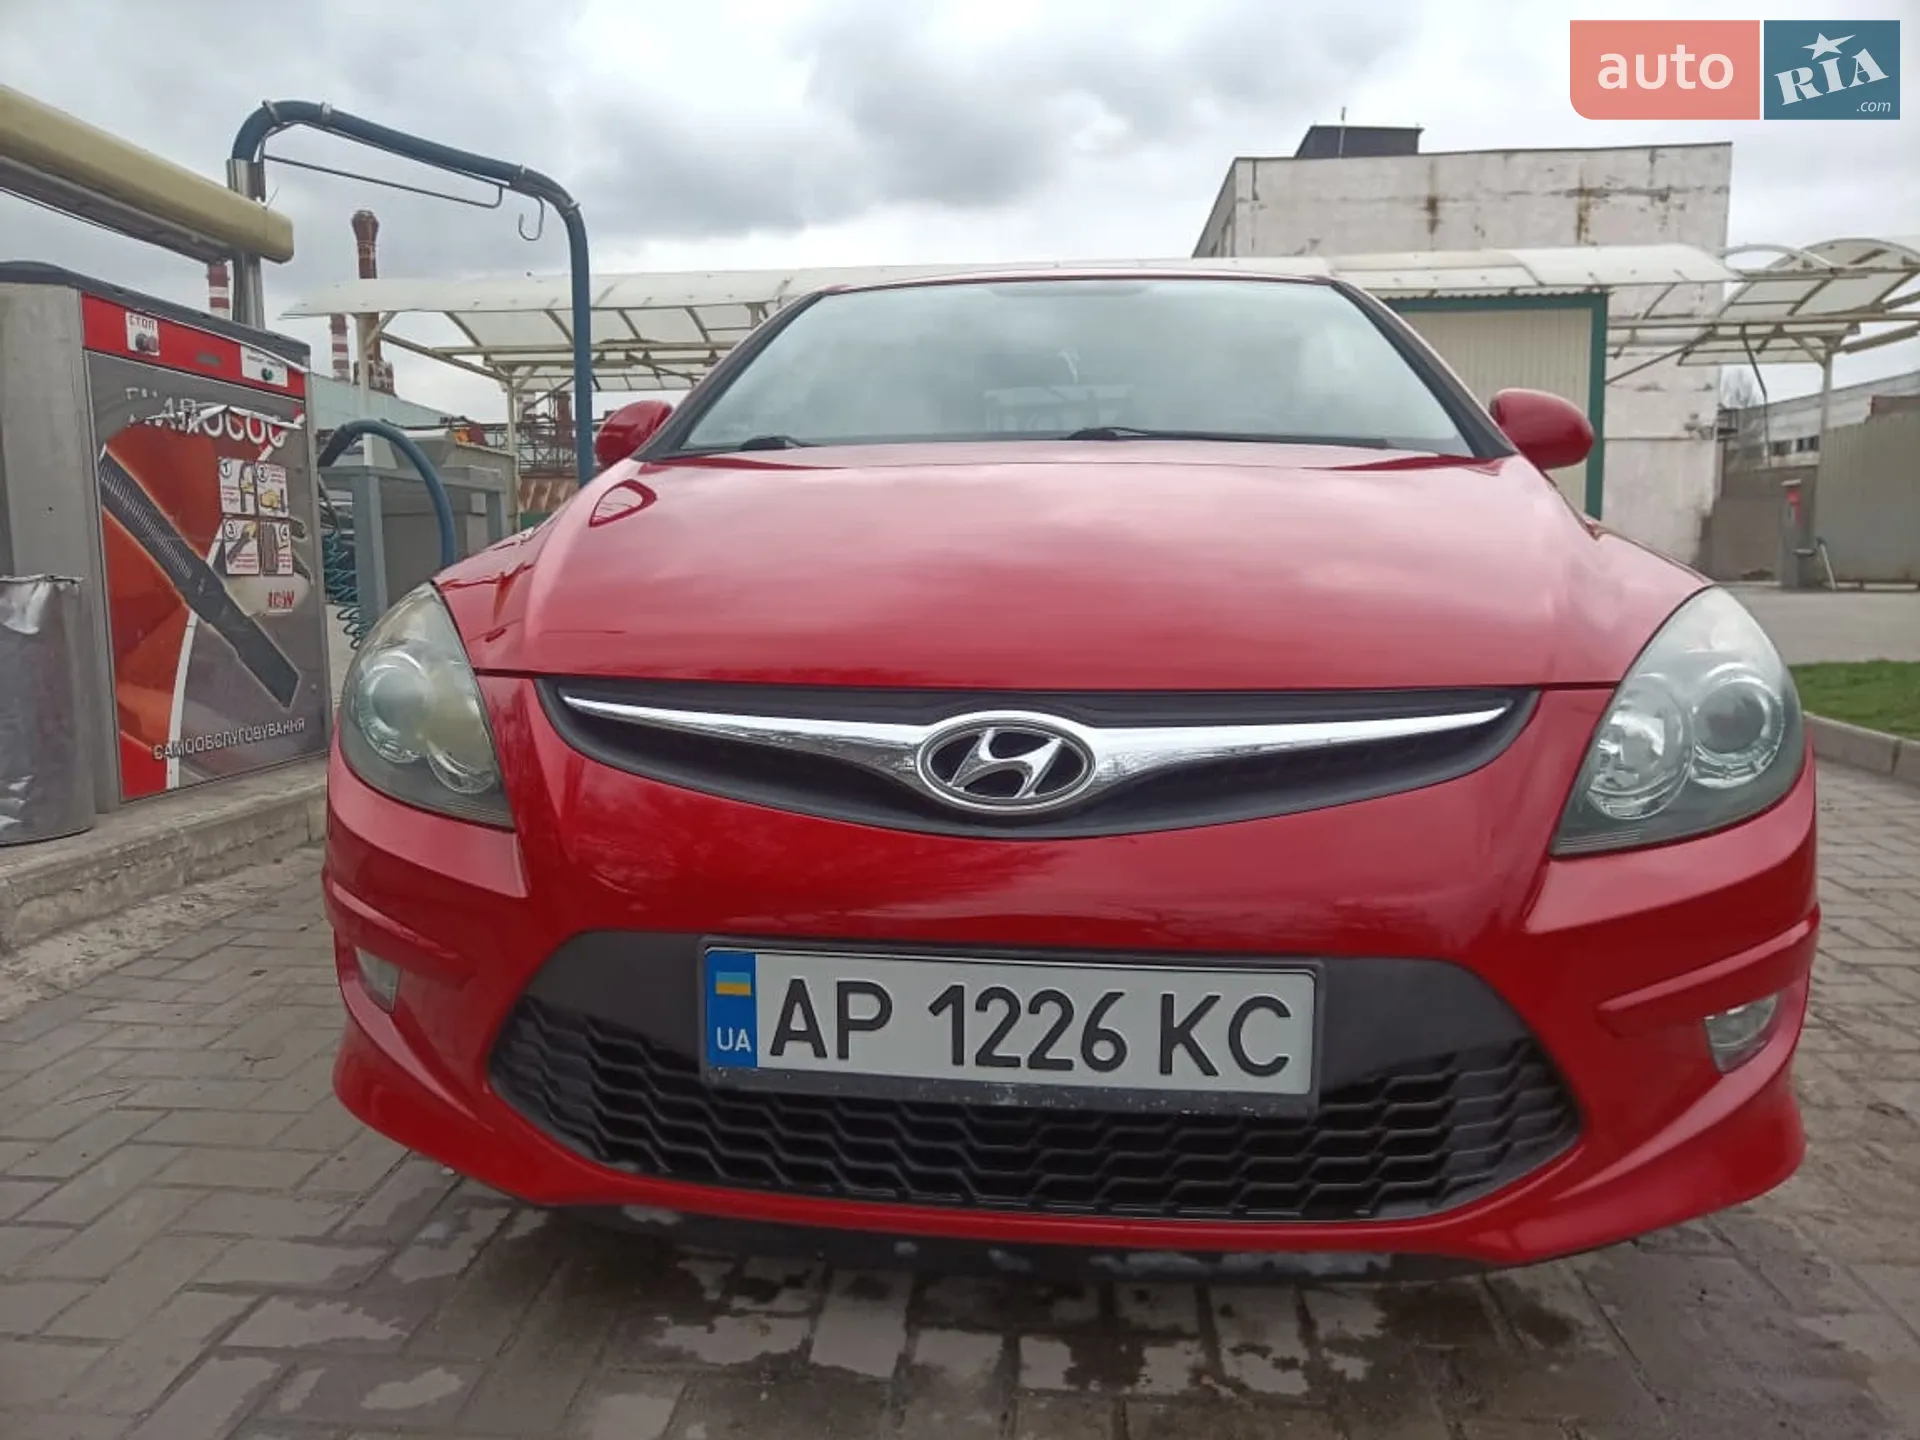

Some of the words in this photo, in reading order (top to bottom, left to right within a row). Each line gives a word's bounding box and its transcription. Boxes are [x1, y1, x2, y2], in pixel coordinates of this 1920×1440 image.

[128, 314, 156, 330] СТОП
[715, 1026, 752, 1053] UA
[769, 978, 893, 1061] AP
[928, 985, 1127, 1073] 1226
[1160, 993, 1292, 1077] KC
